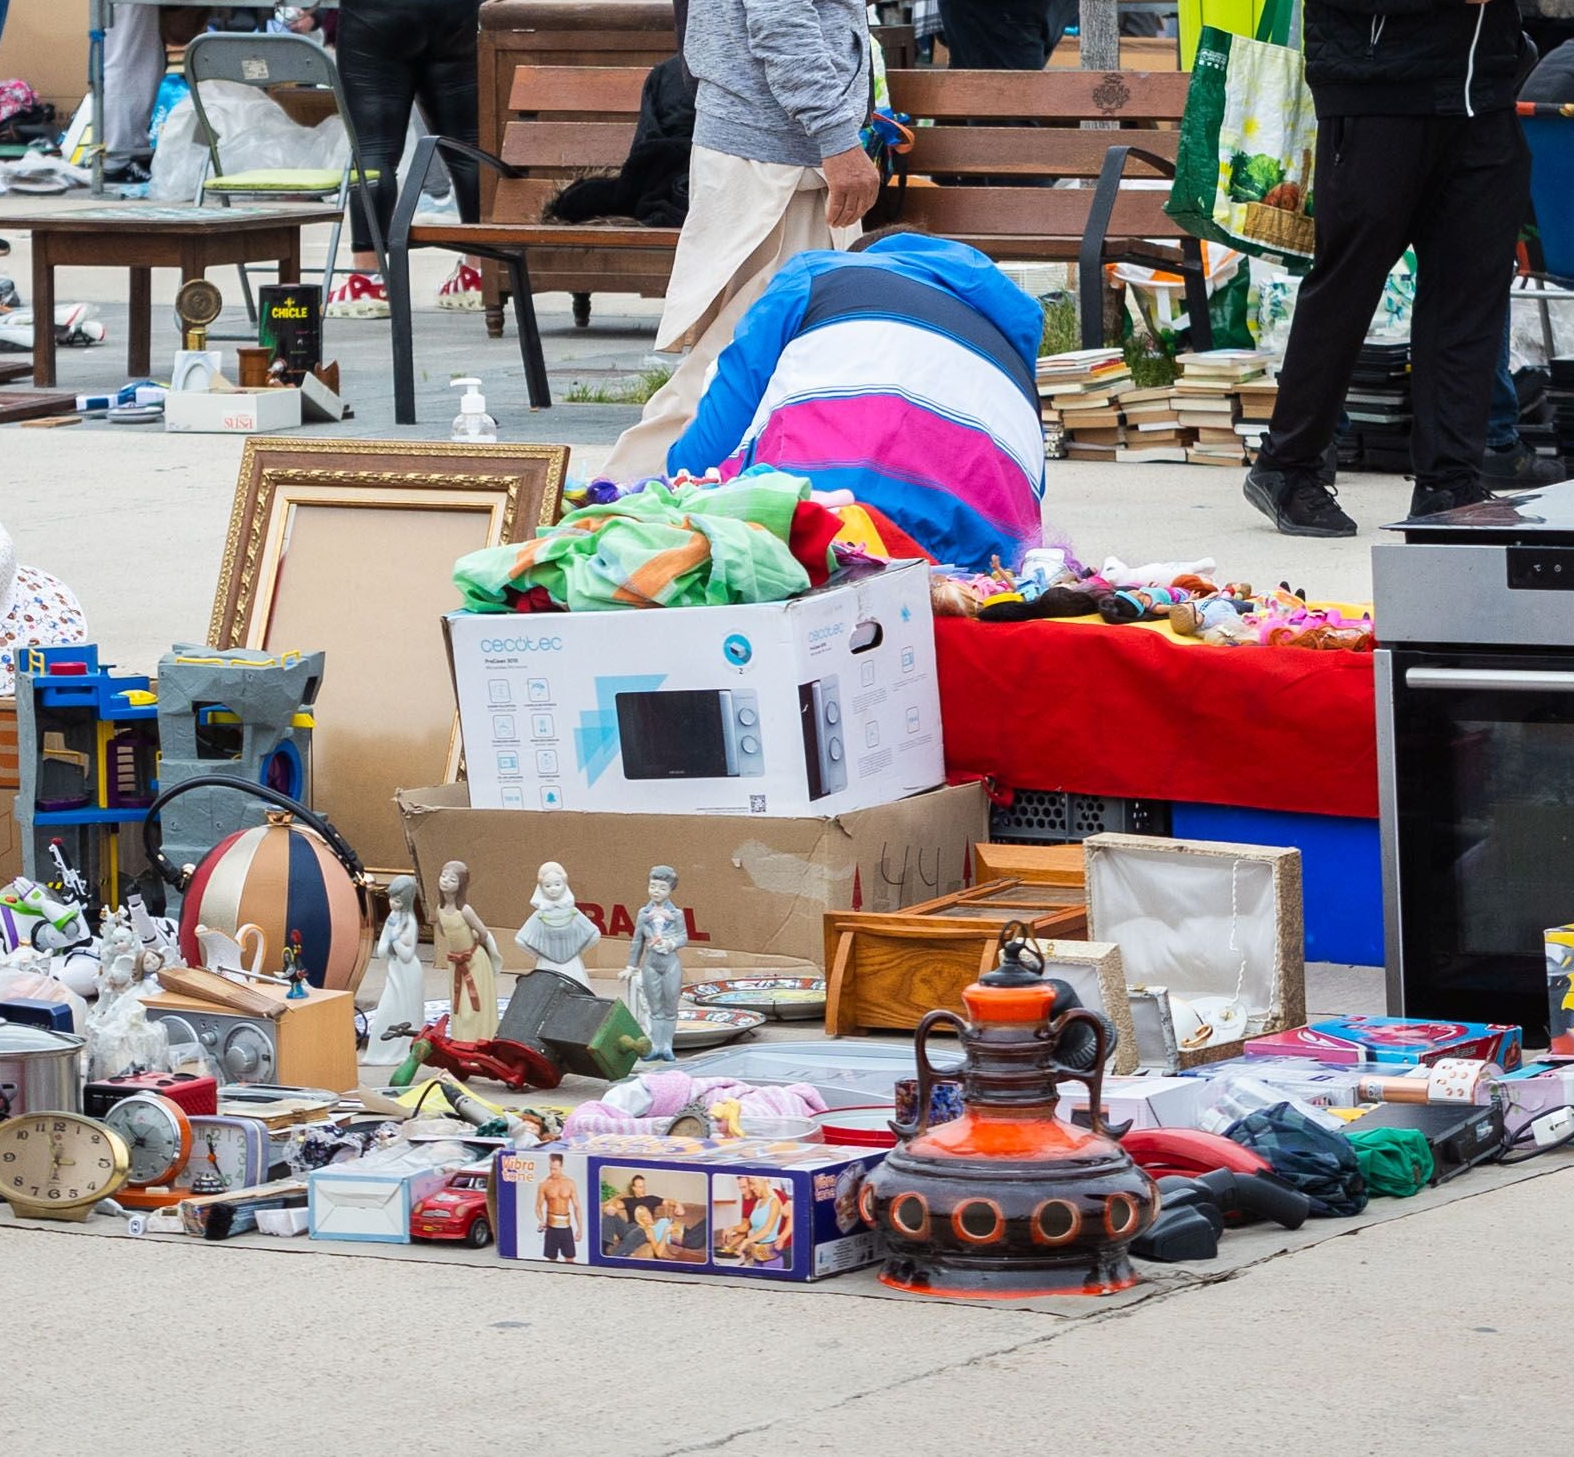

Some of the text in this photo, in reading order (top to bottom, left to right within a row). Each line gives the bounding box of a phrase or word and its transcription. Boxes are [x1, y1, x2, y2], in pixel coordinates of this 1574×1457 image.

[272, 307, 308, 318] CHICLE
[225, 418, 252, 429] susa
[481, 637, 563, 652] cecotec
[35, 1123, 45, 1132] 11
[53, 1122, 66, 1132] 12
[17, 1130, 29, 1140] 10
[3, 1152, 16, 1162] 9
[502, 1155, 535, 1171] Vibra
[14, 1176, 23, 1186] 8
[502, 1170, 535, 1183] tone
[31, 1187, 40, 1196] 7
[87, 1182, 96, 1191] 4
[48, 1189, 61, 1199] 6
[69, 1189, 78, 1198] 5
